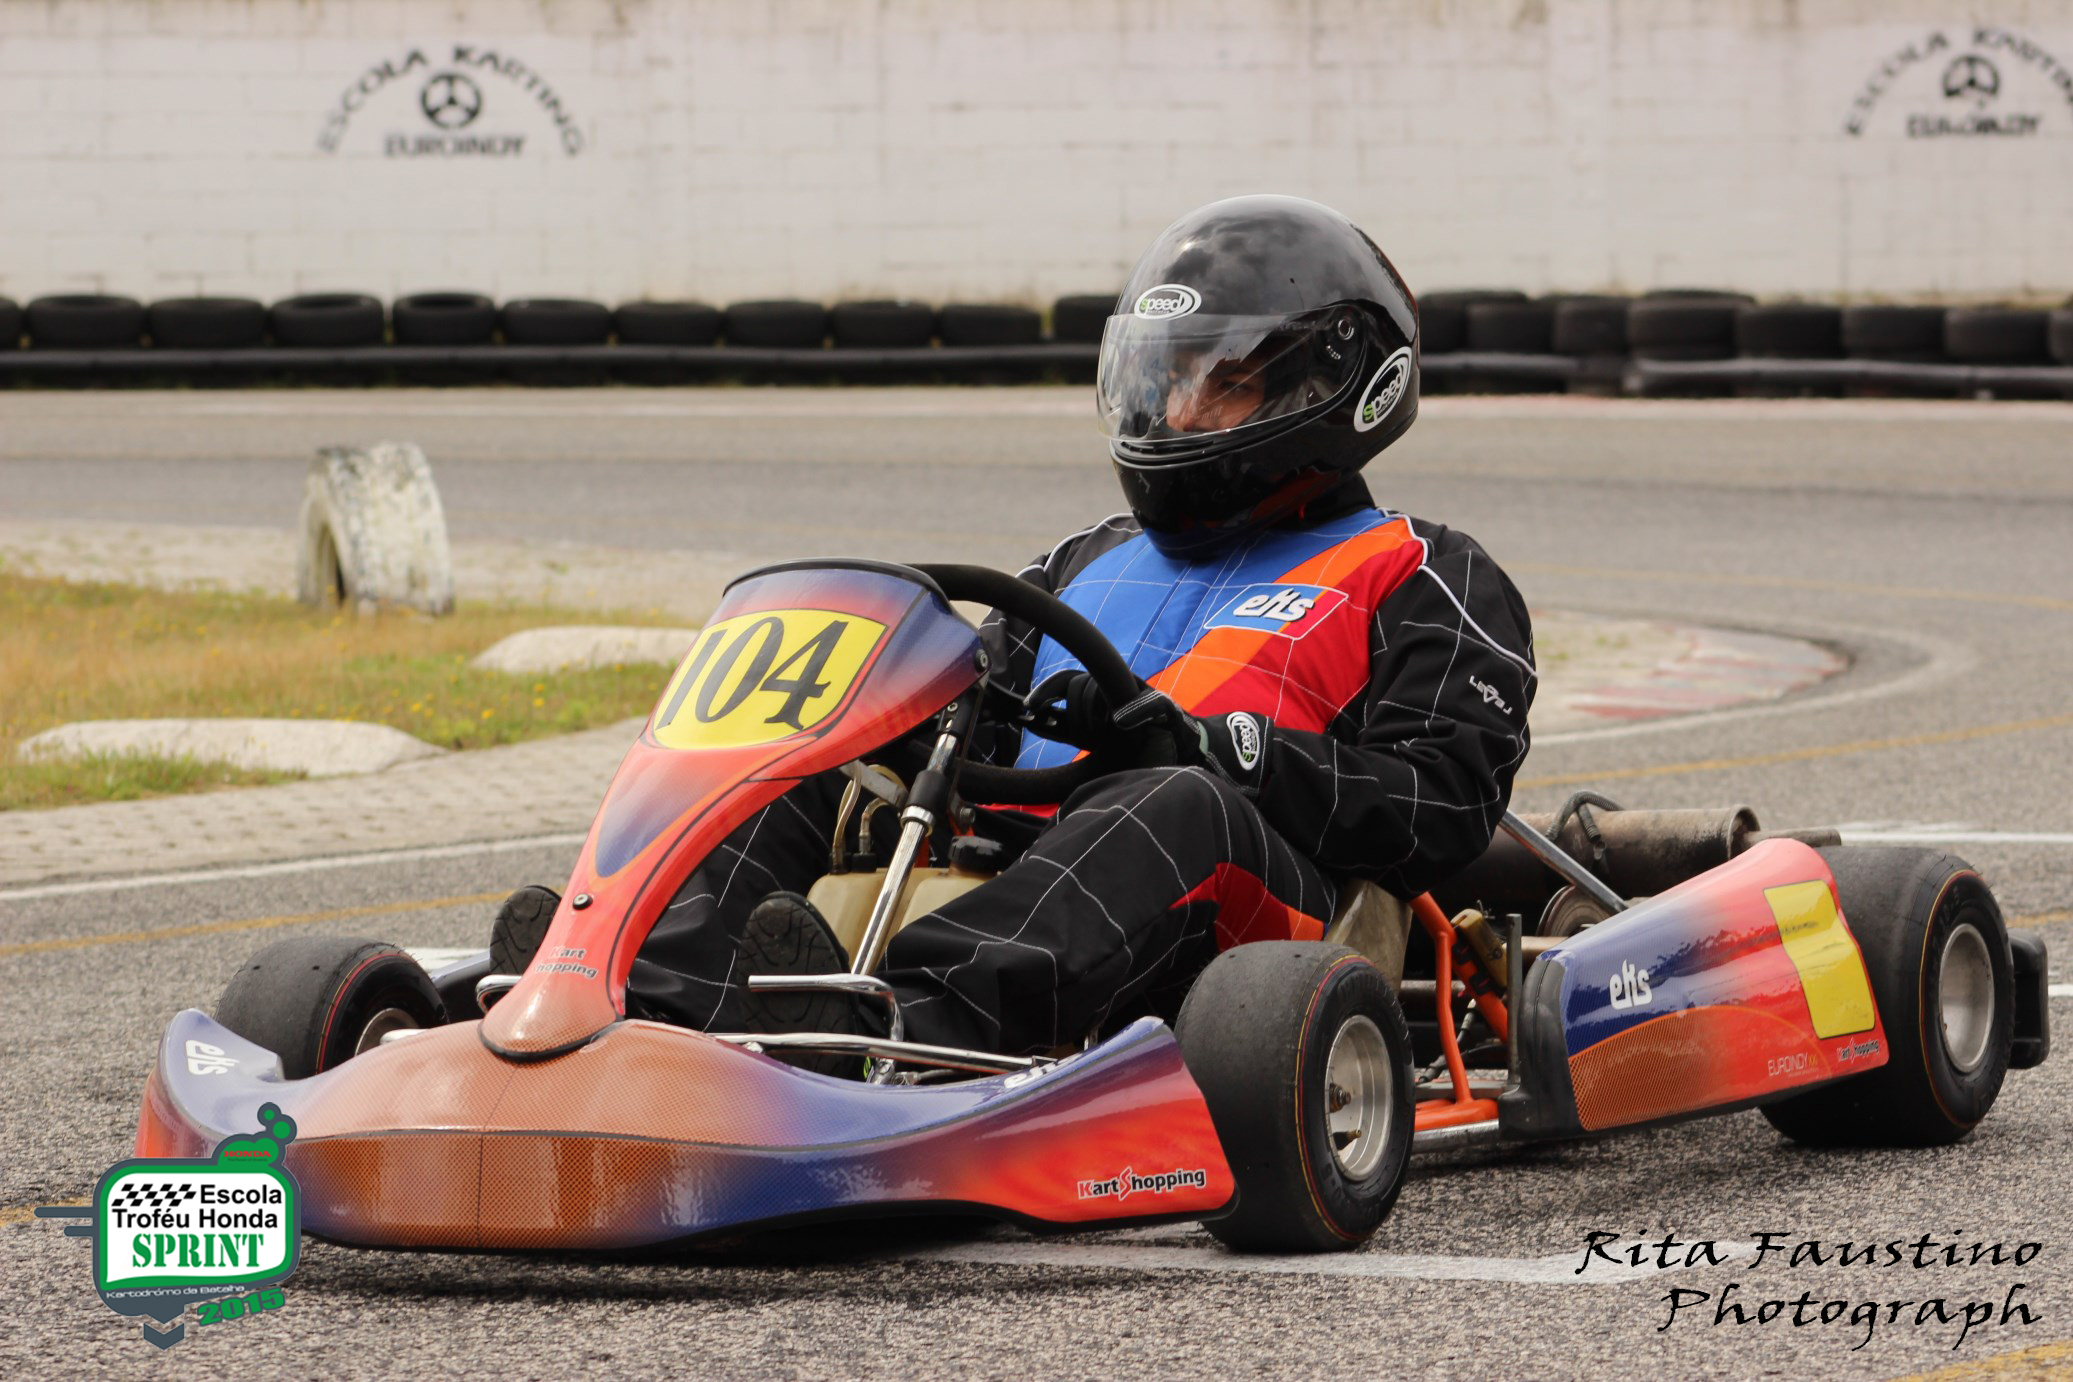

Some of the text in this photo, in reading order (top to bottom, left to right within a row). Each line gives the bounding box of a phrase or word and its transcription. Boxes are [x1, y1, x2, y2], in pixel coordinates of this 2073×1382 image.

[316, 45, 585, 156] ESCOLA KARTING
[1140, 293, 1183, 316] speed
[1362, 363, 1404, 421] speed
[655, 617, 849, 731] 104
[1234, 722, 1257, 762] speed
[551, 946, 586, 959] Kart
[1078, 1165, 1206, 1201] KartShopping
